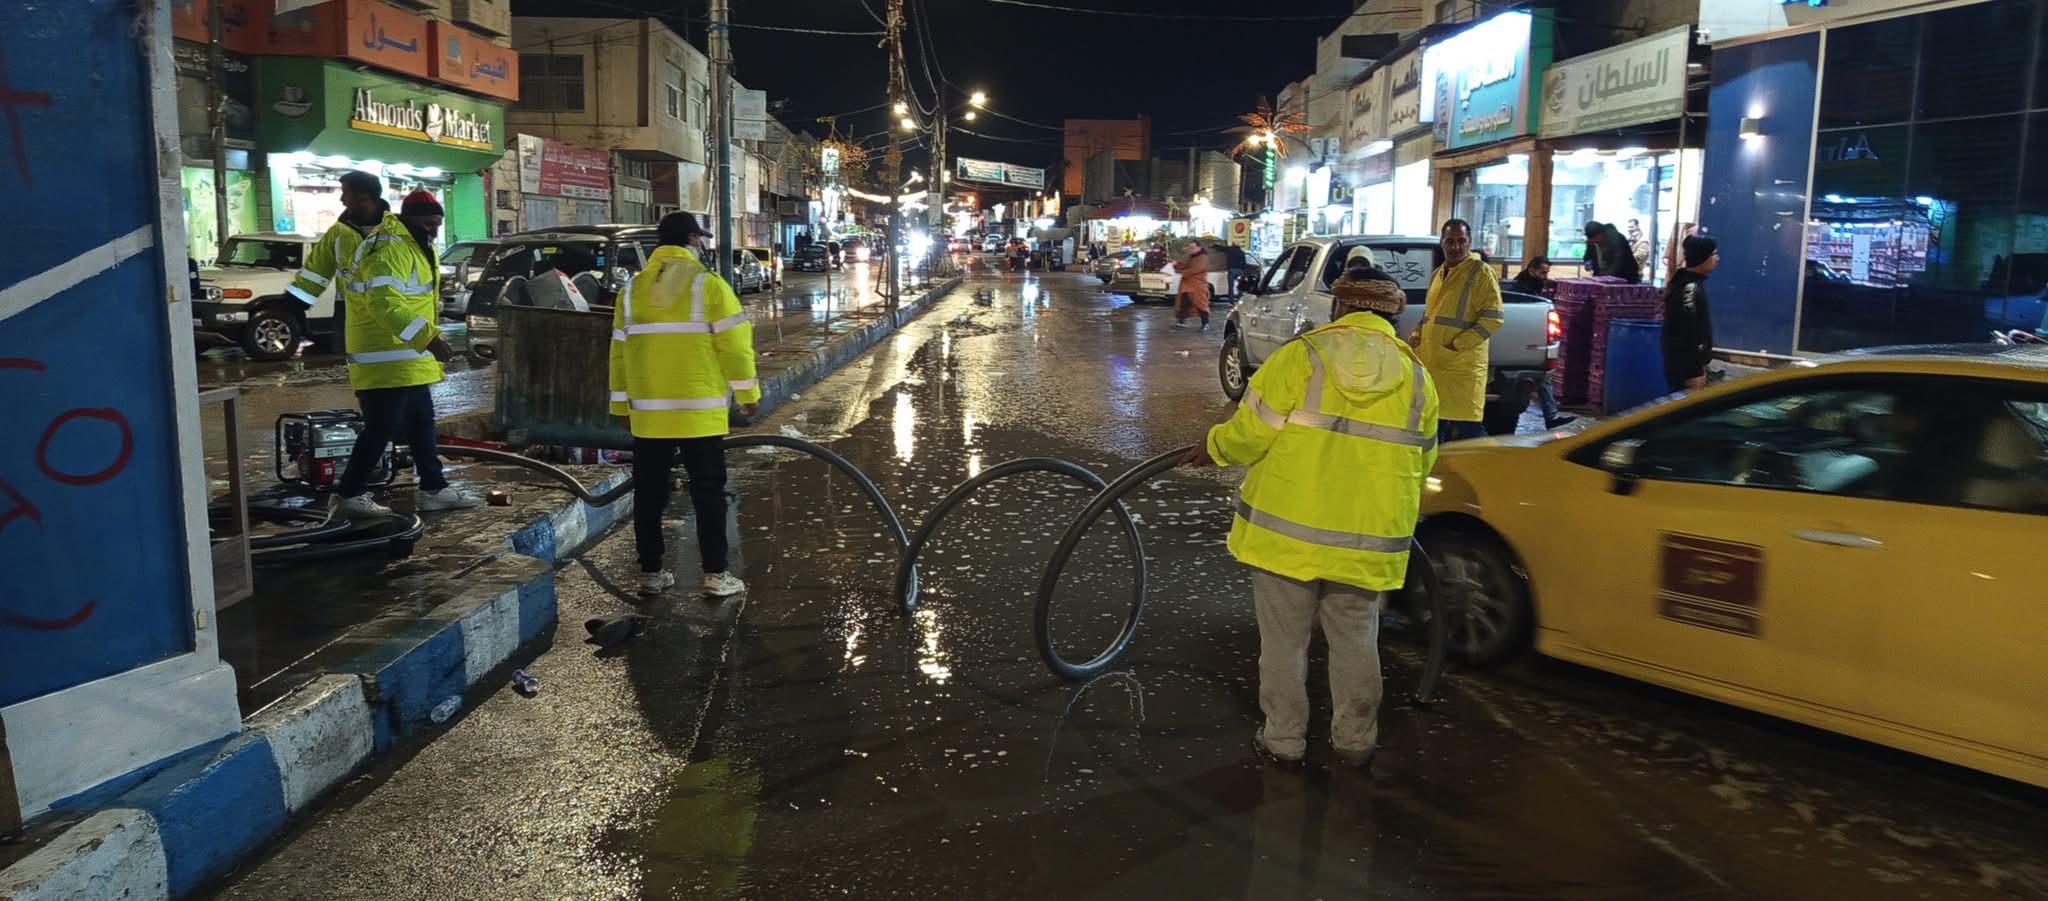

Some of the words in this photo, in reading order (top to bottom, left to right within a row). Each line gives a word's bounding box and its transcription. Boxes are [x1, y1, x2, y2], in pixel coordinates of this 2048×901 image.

[364, 11, 417, 52] مول
[1577, 46, 1670, 111] السلطان
[354, 87, 423, 132] Almonds
[445, 107, 492, 143] Market
